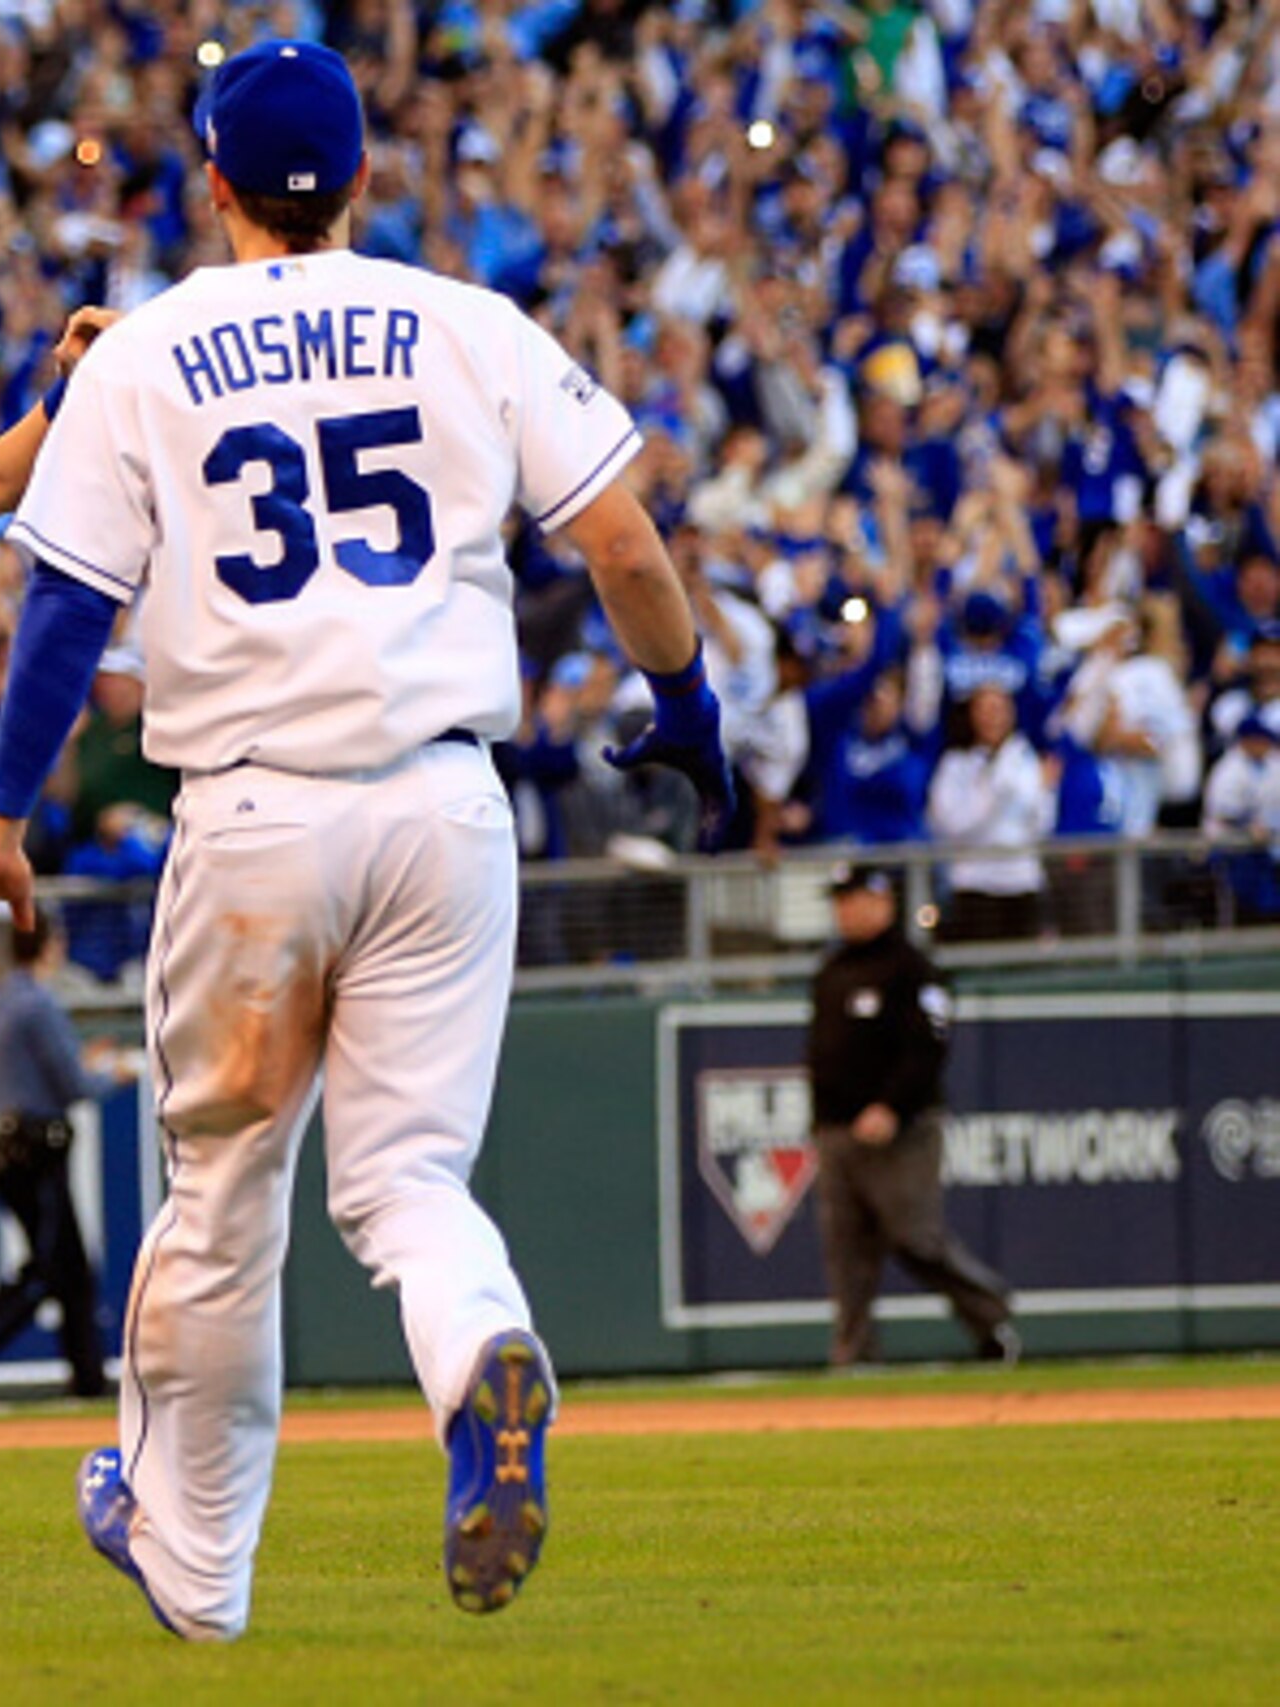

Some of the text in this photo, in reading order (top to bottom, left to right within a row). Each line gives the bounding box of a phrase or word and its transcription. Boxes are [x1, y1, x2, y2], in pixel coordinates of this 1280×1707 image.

[172, 306, 420, 405] HOSMER
[202, 405, 436, 606] 35
[940, 1109, 1180, 1187] NETWORK
